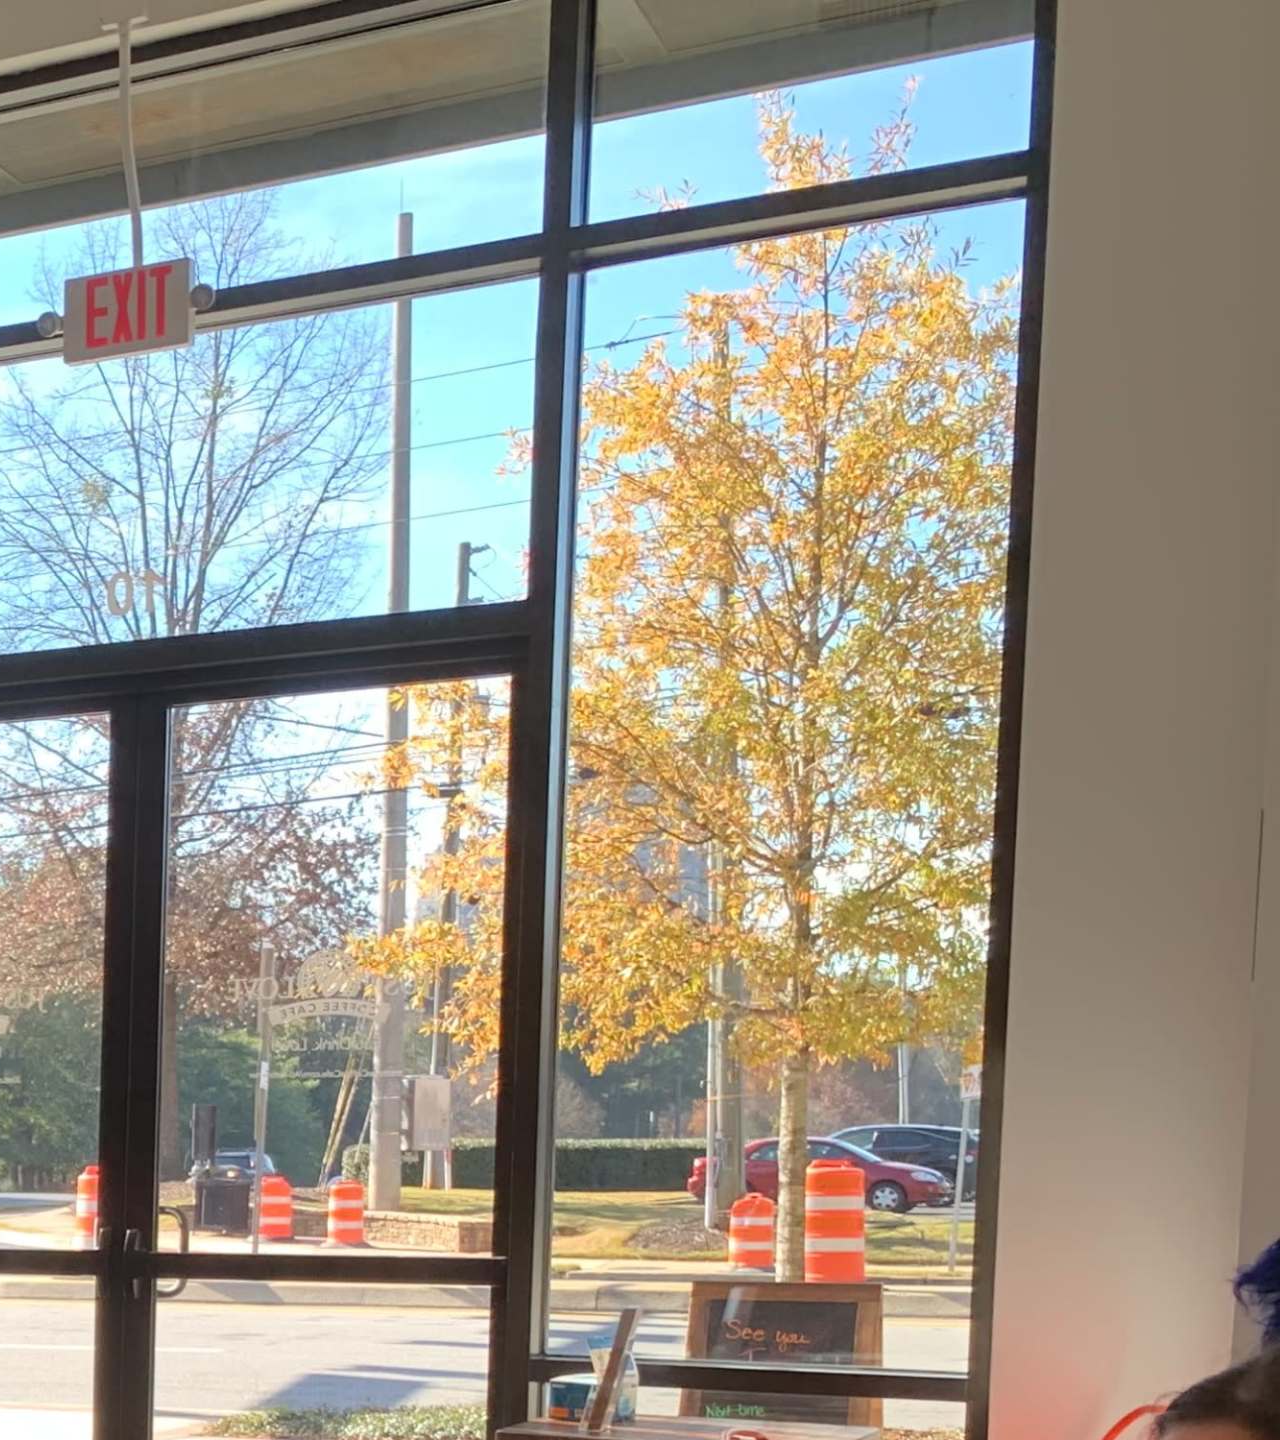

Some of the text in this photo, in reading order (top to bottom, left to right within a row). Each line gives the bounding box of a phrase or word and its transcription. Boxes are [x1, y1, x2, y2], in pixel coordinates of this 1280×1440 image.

[86, 265, 172, 348] EXIT
[725, 1318, 811, 1352] See you
